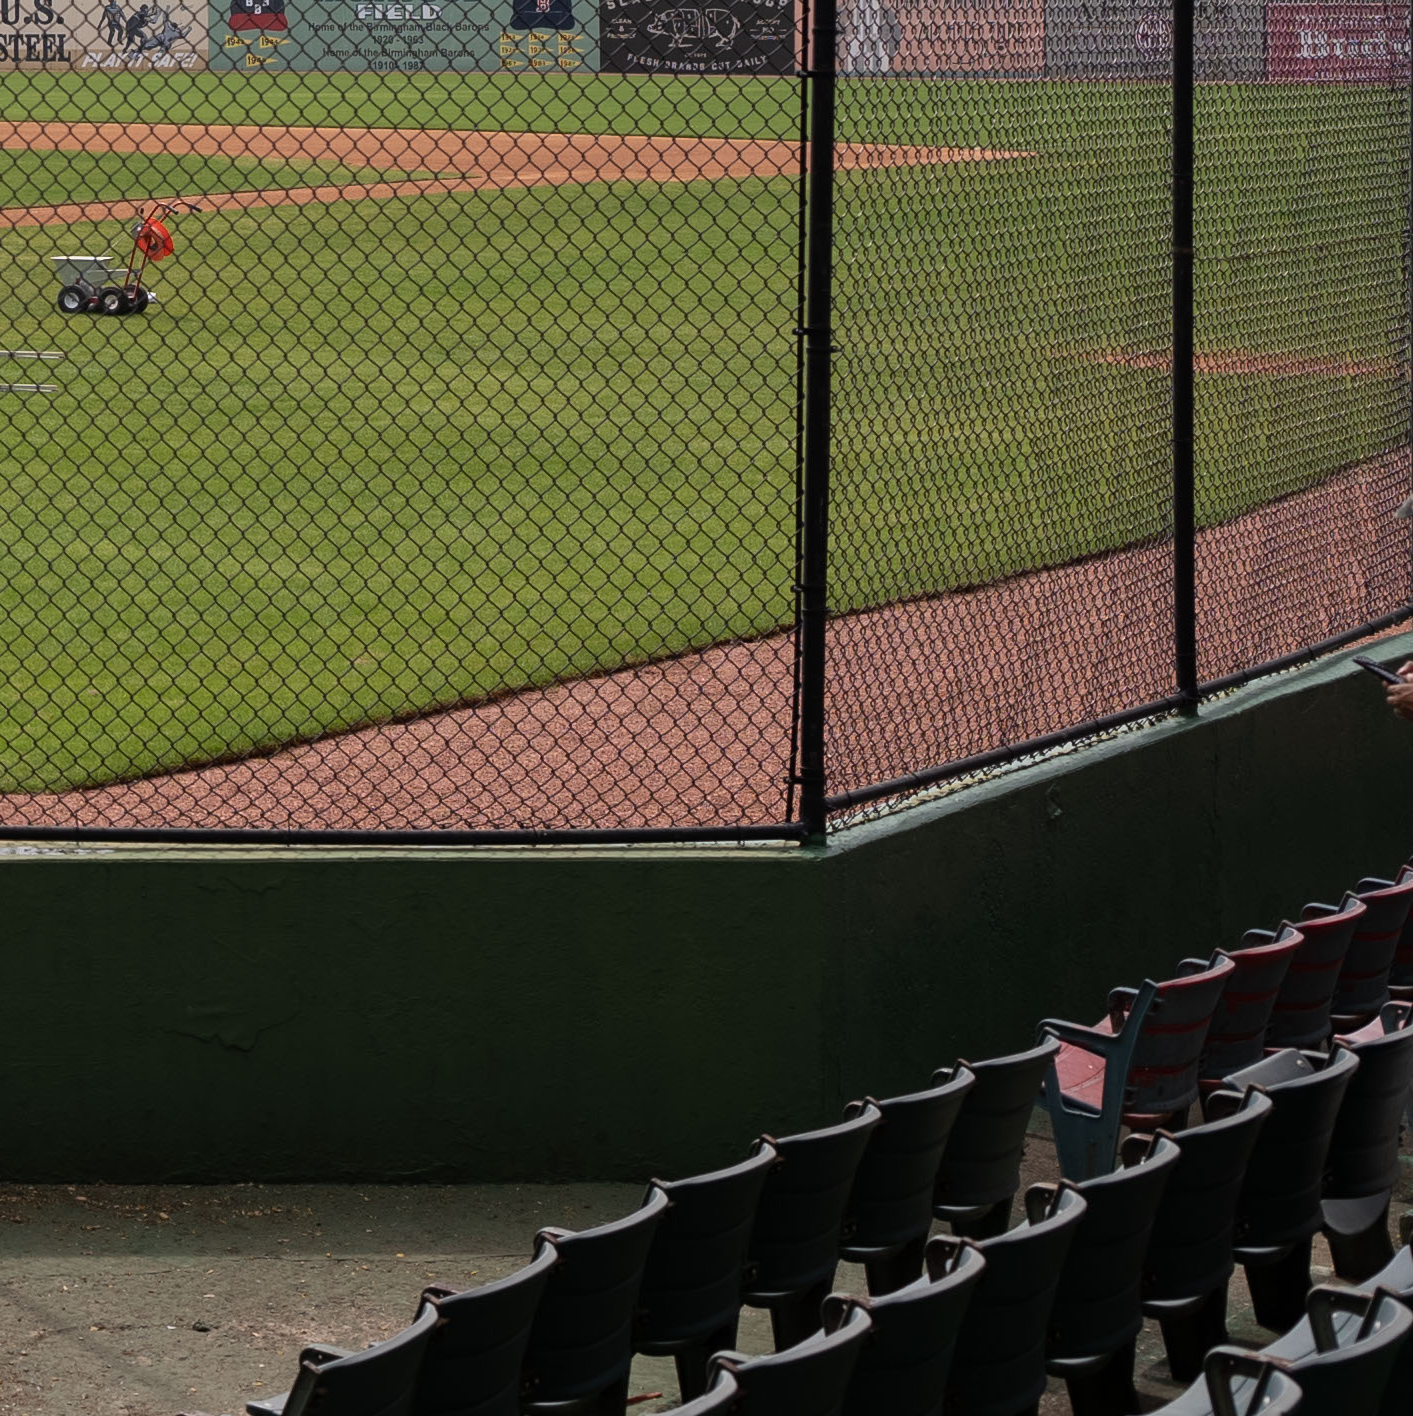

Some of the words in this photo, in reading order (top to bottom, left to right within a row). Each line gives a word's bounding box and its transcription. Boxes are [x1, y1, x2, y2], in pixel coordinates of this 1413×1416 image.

[356, 3, 443, 21] FIELD
[308, 22, 336, 32] Home
[349, 22, 365, 32] the
[367, 22, 423, 34] Birmingham
[425, 22, 452, 32] Black
[455, 22, 490, 32] Barons
[323, 48, 350, 58] Home
[363, 48, 379, 58] the
[381, 48, 438, 59] Birmingham
[440, 48, 476, 58] Barons
[81, 52, 126, 68] PLAY
[147, 52, 199, 68] SAFE!
[373, 61, 395, 71] 1910
